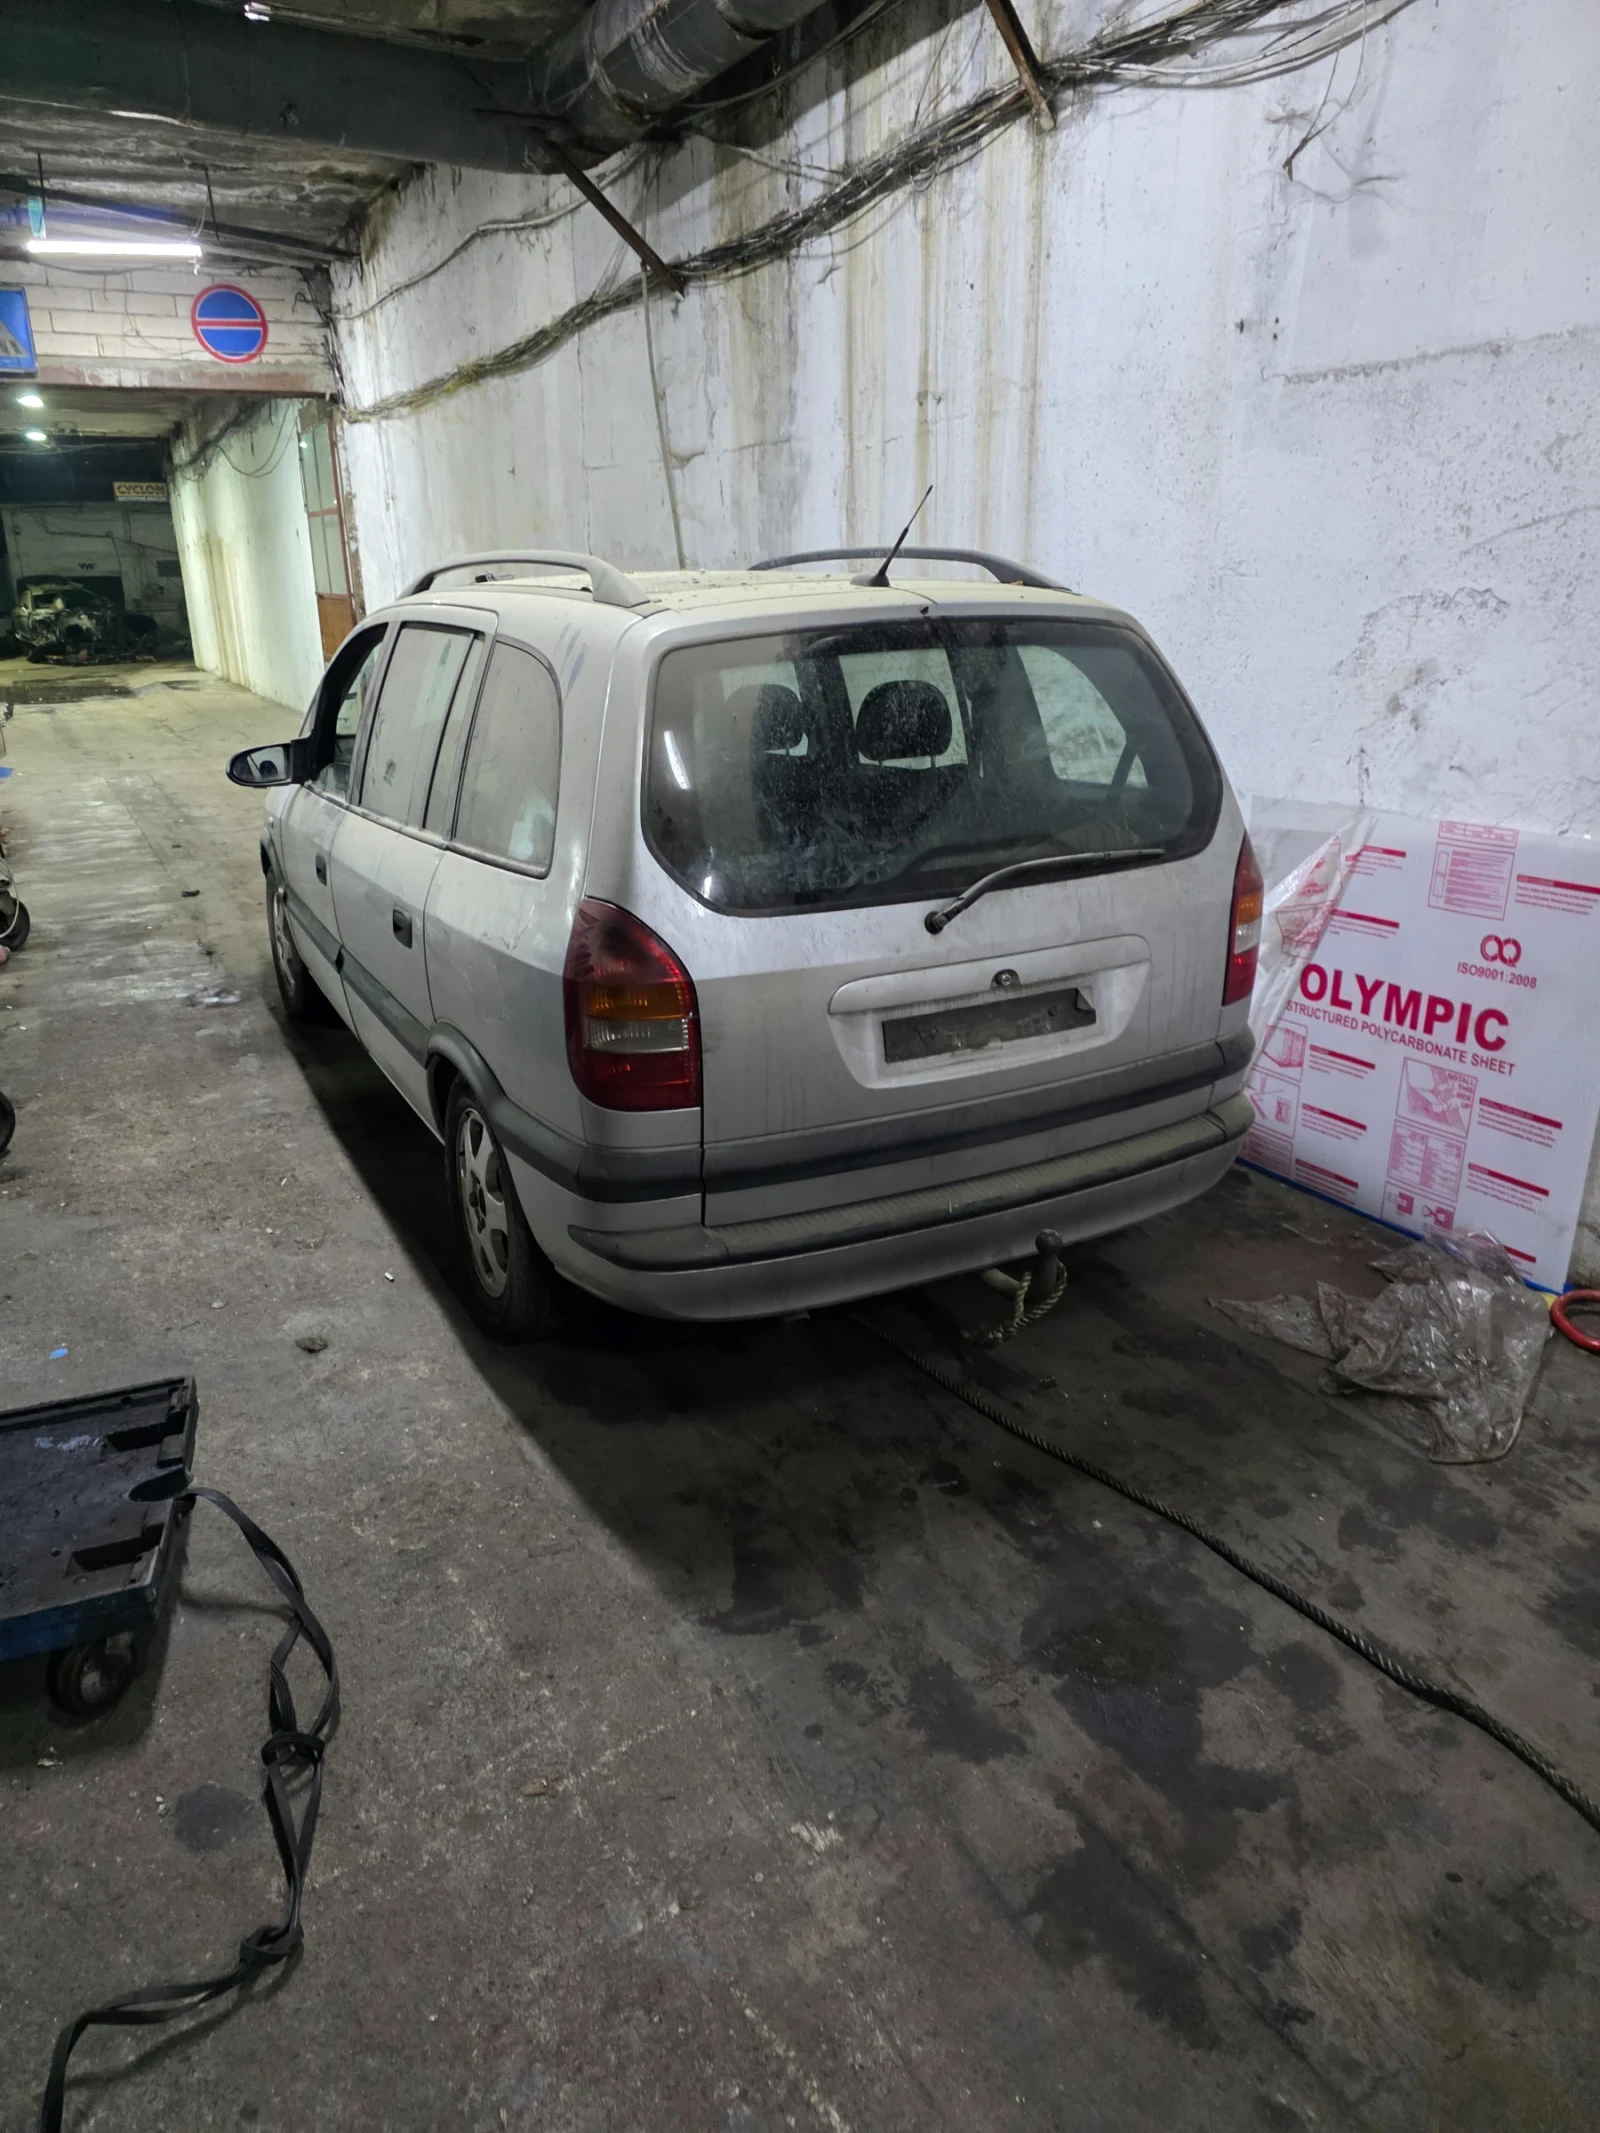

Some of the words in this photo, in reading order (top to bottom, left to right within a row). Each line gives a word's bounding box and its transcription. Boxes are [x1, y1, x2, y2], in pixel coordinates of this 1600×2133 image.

[1299, 963, 1510, 1052] OLYMPIC
[1457, 962, 1538, 989] ISO9001:2008
[1286, 1000, 1359, 1031] STRUCTURED
[1361, 1021, 1468, 1065] POLYCARBONATE
[1471, 1053, 1516, 1077] SHEET
